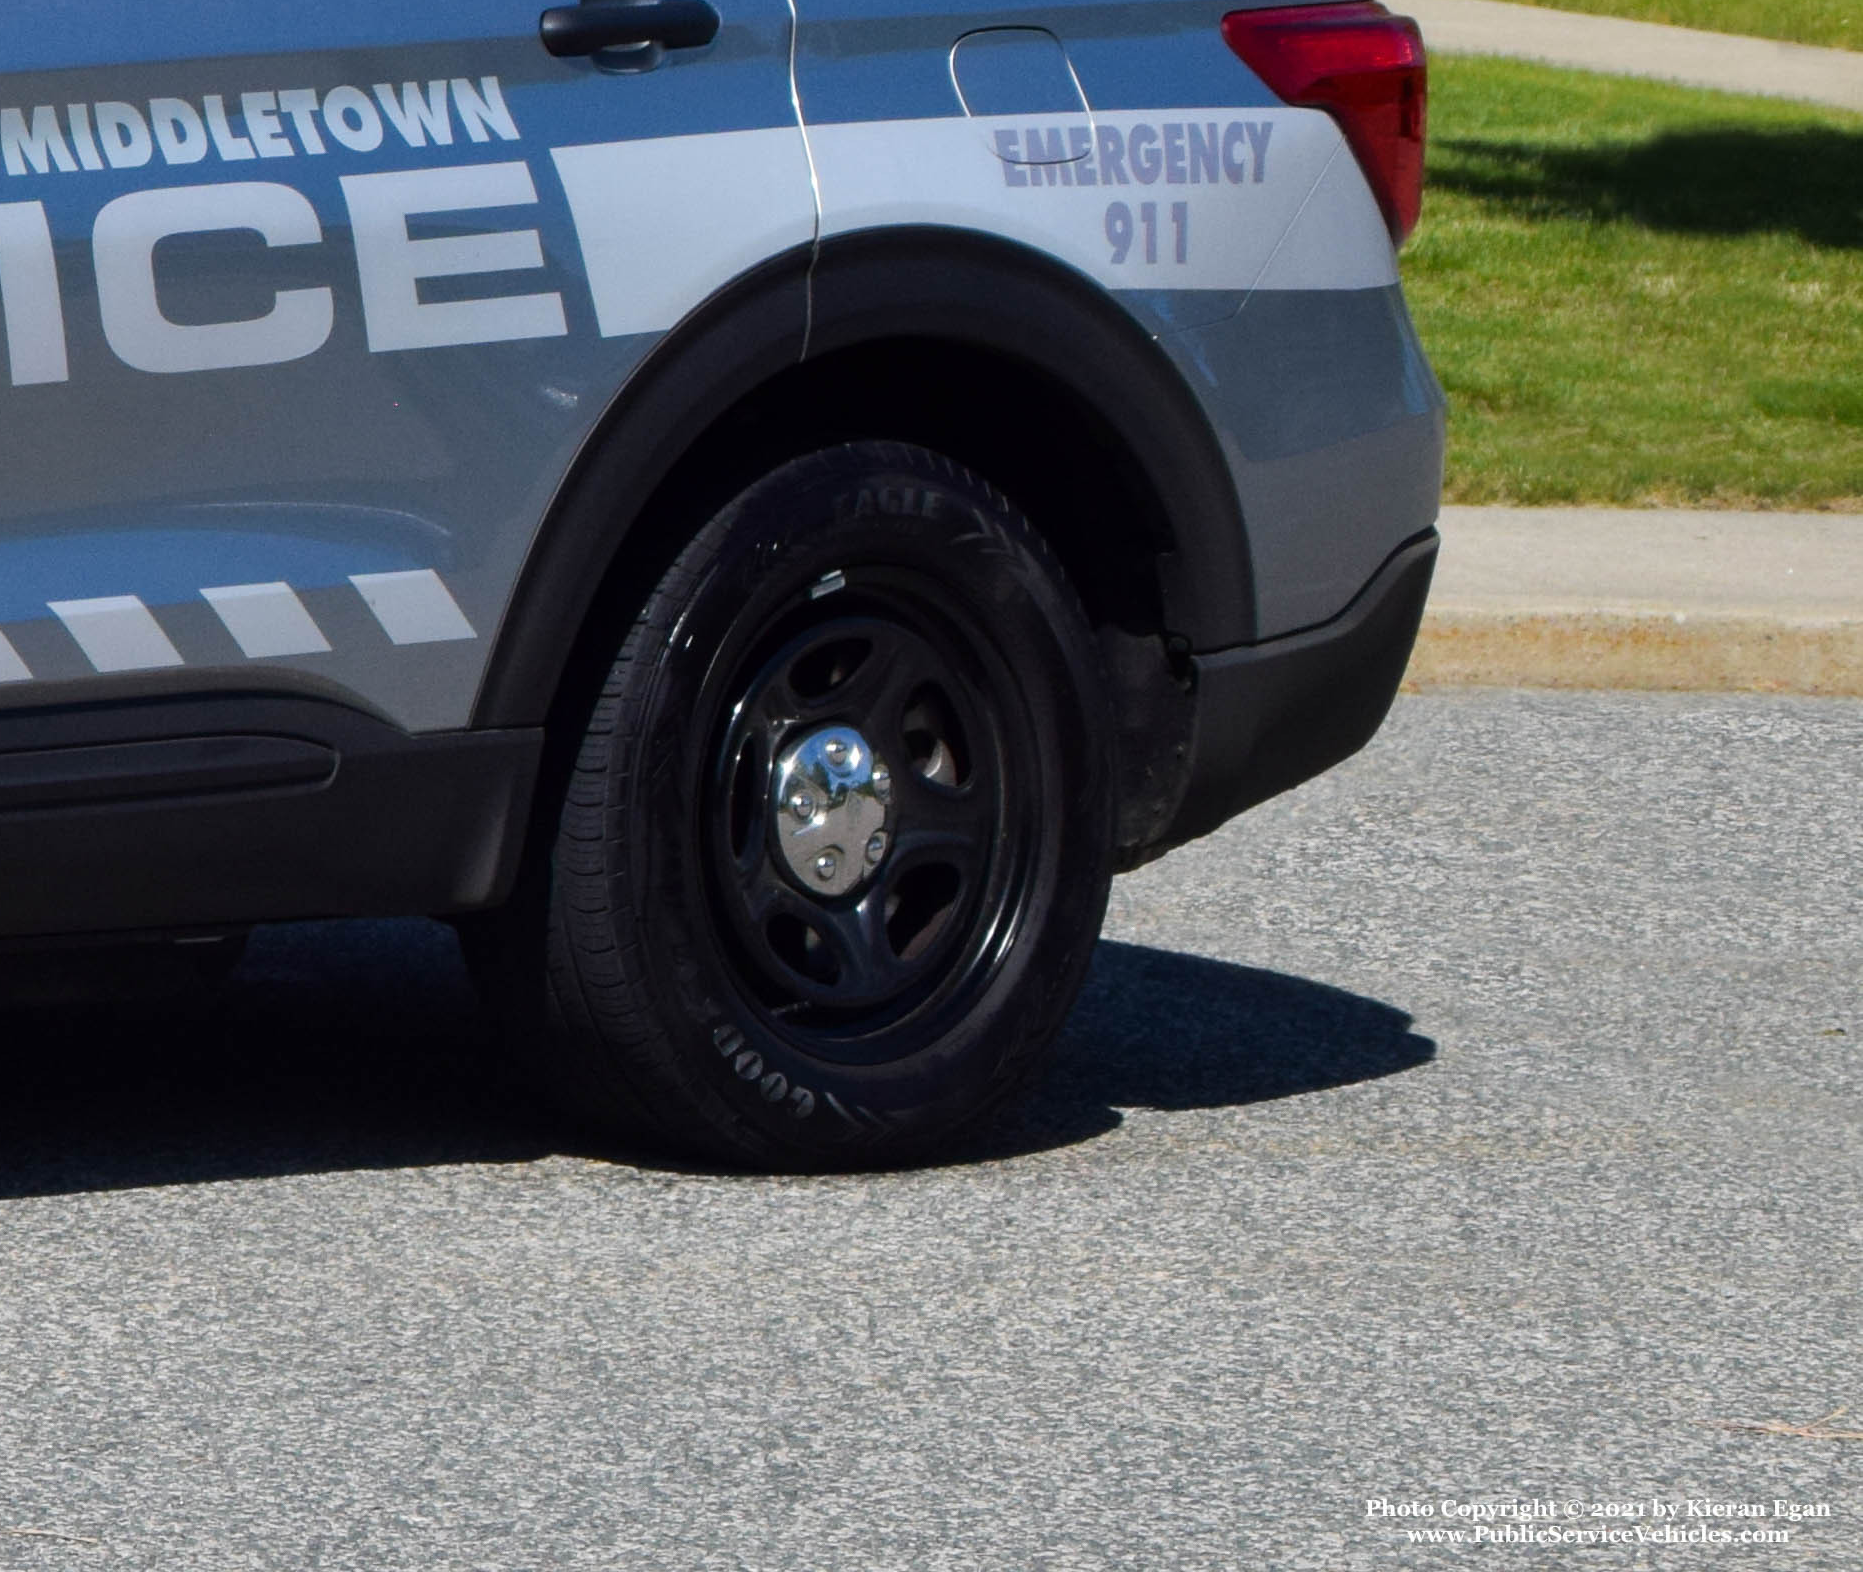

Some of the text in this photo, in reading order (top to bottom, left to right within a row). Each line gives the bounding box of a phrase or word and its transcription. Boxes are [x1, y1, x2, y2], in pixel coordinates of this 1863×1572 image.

[0, 76, 521, 176] MIDDLETOWN
[994, 121, 1274, 187] EMERGENCY
[1105, 201, 1188, 264] 911
